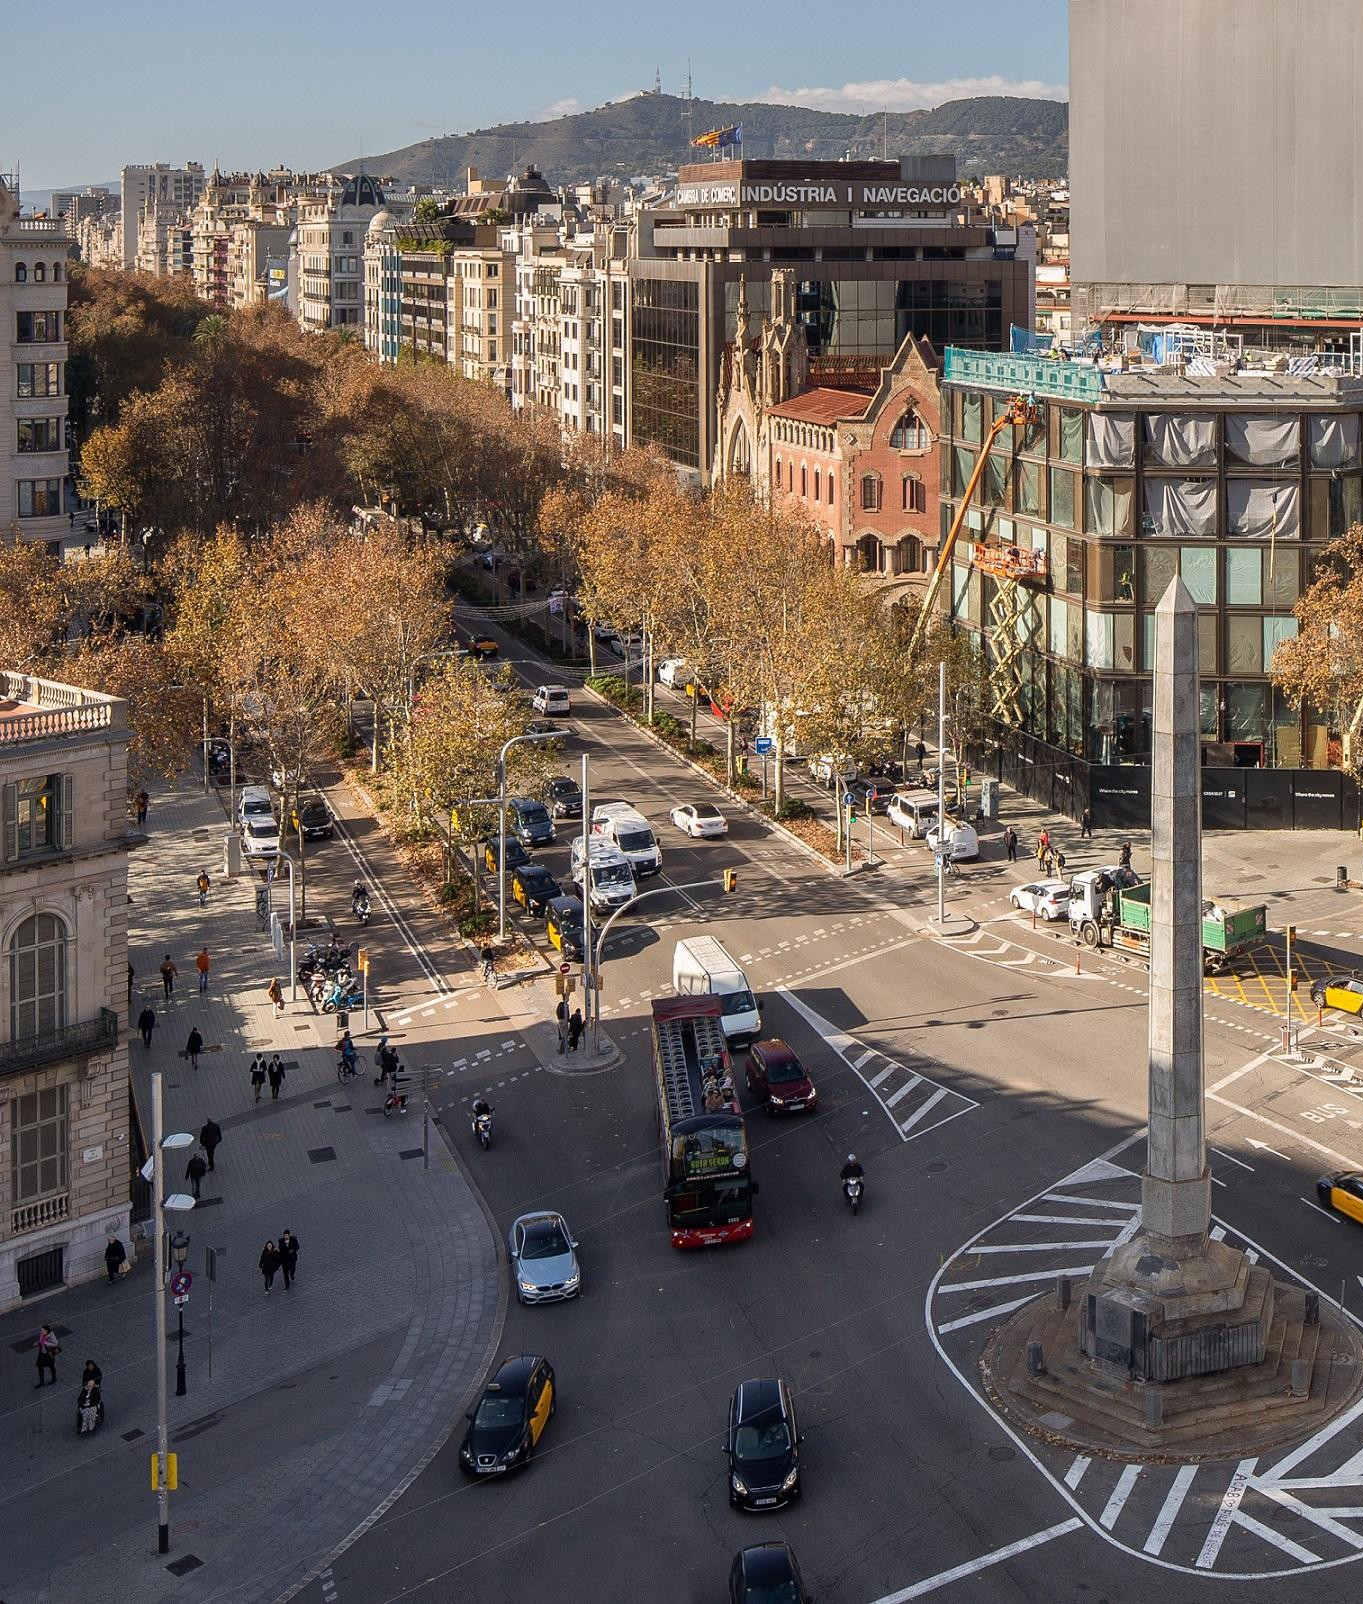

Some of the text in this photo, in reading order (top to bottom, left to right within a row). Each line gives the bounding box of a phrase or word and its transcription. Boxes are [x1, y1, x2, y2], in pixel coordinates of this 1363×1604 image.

[677, 189, 699, 204] CAMBRA
[701, 188, 709, 203] DE
[742, 183, 961, 204] INDÚSTRIA I NAVEGACIÓ
[1299, 1103, 1349, 1123] BUS
